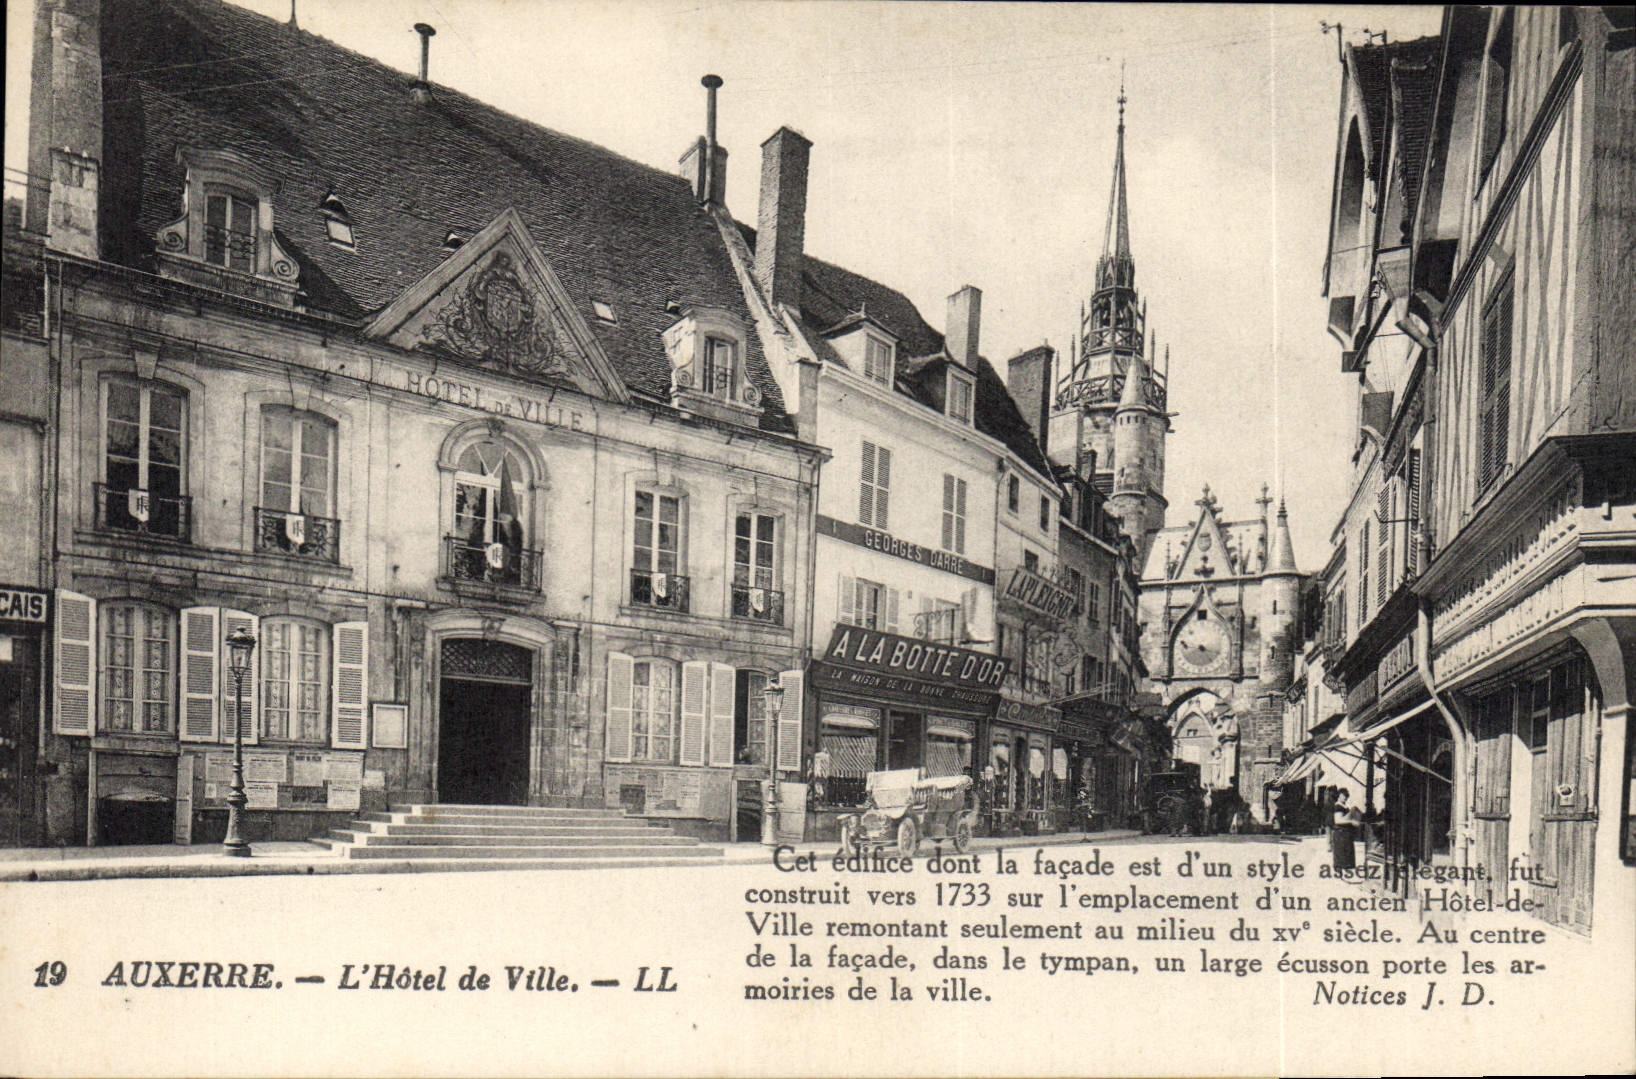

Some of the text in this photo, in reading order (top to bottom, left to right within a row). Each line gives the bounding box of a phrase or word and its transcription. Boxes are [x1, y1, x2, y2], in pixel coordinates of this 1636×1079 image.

[519, 397, 583, 431] VILLE
[865, 530, 963, 575] GEORGES DARRE
[855, 634, 886, 665] LA
[889, 641, 959, 676] BOTTE
[960, 655, 1005, 685] D'OR
[831, 669, 842, 680] LA
[851, 673, 881, 687] MAISON
[886, 679, 897, 689] DE
[903, 682, 914, 692] LA
[920, 687, 945, 698] BONNE
